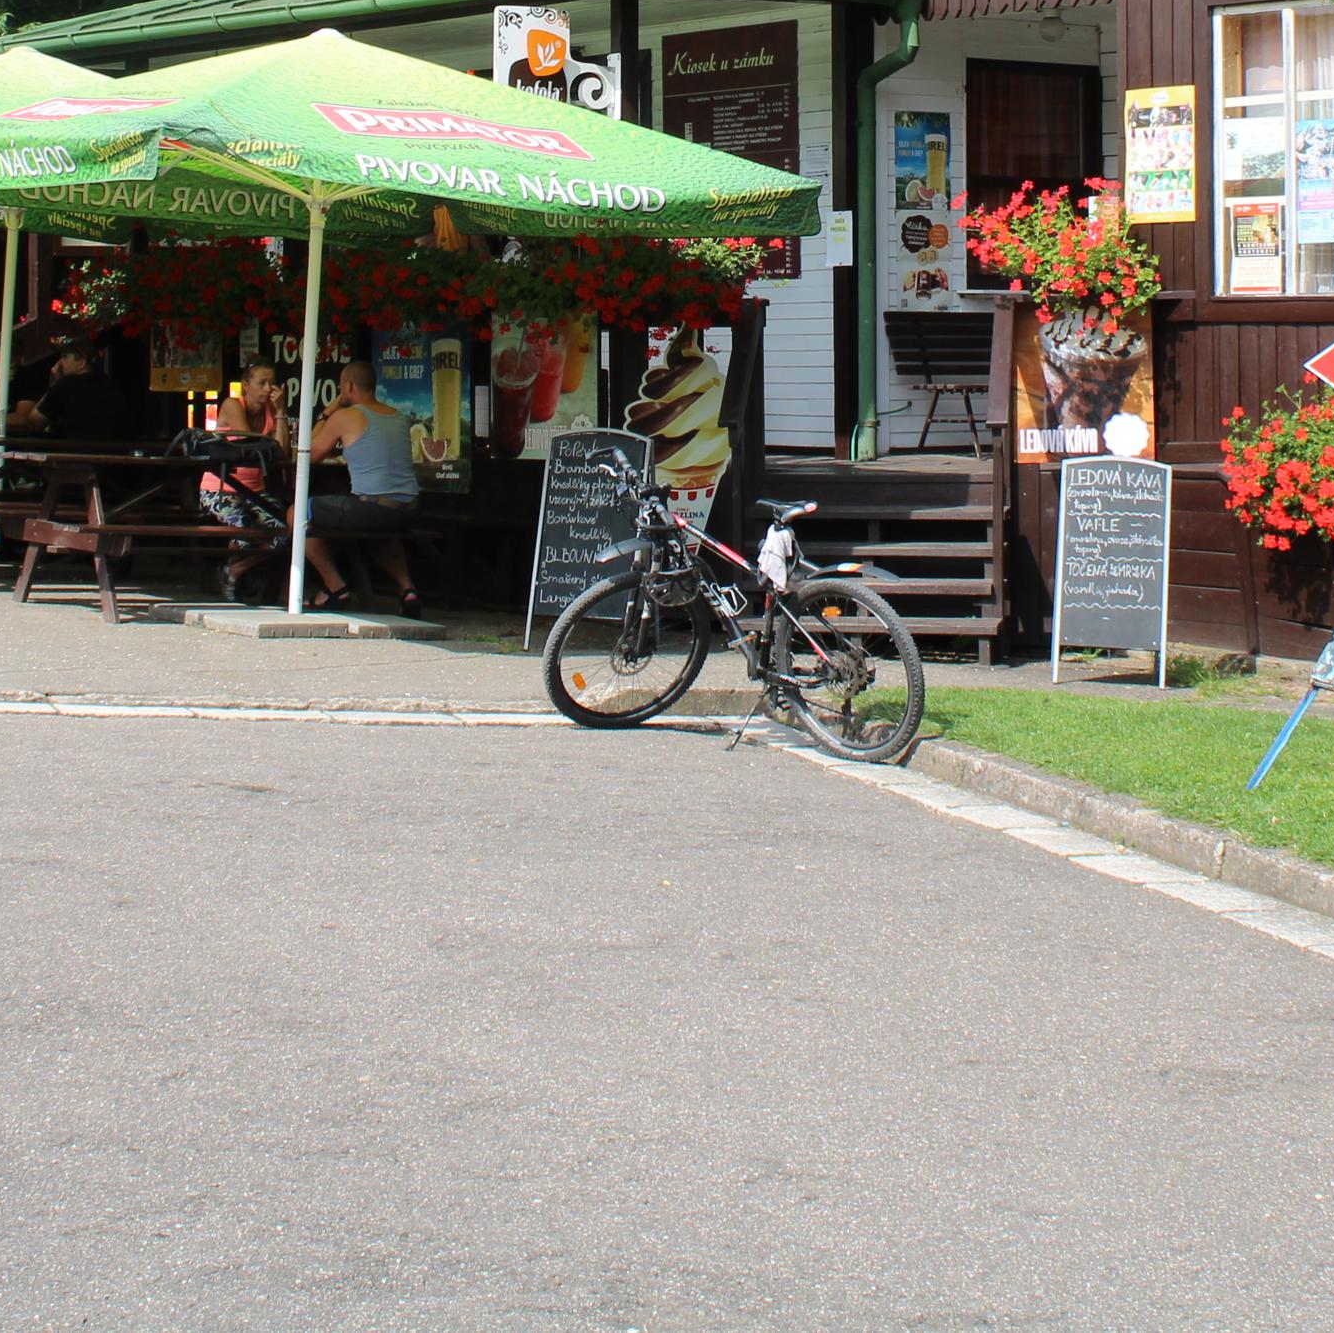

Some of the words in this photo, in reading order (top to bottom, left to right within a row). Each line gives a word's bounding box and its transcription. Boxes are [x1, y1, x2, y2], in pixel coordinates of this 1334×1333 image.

[667, 52, 716, 76] Kiosek
[720, 60, 728, 70] u
[733, 47, 774, 70] zámku
[88, 130, 144, 162] Specialista
[355, 154, 508, 198] PIVOVAR
[517, 171, 666, 215] NÁCHOD
[706, 185, 795, 209] Specialista
[271, 334, 351, 364] TON
[287, 377, 338, 409] PVO
[1020, 424, 1064, 453] LEDOVÁ
[1065, 425, 1098, 453] KÁVA
[1070, 464, 1122, 486] LEDOVÁ
[1077, 516, 1120, 532] VAFLE
